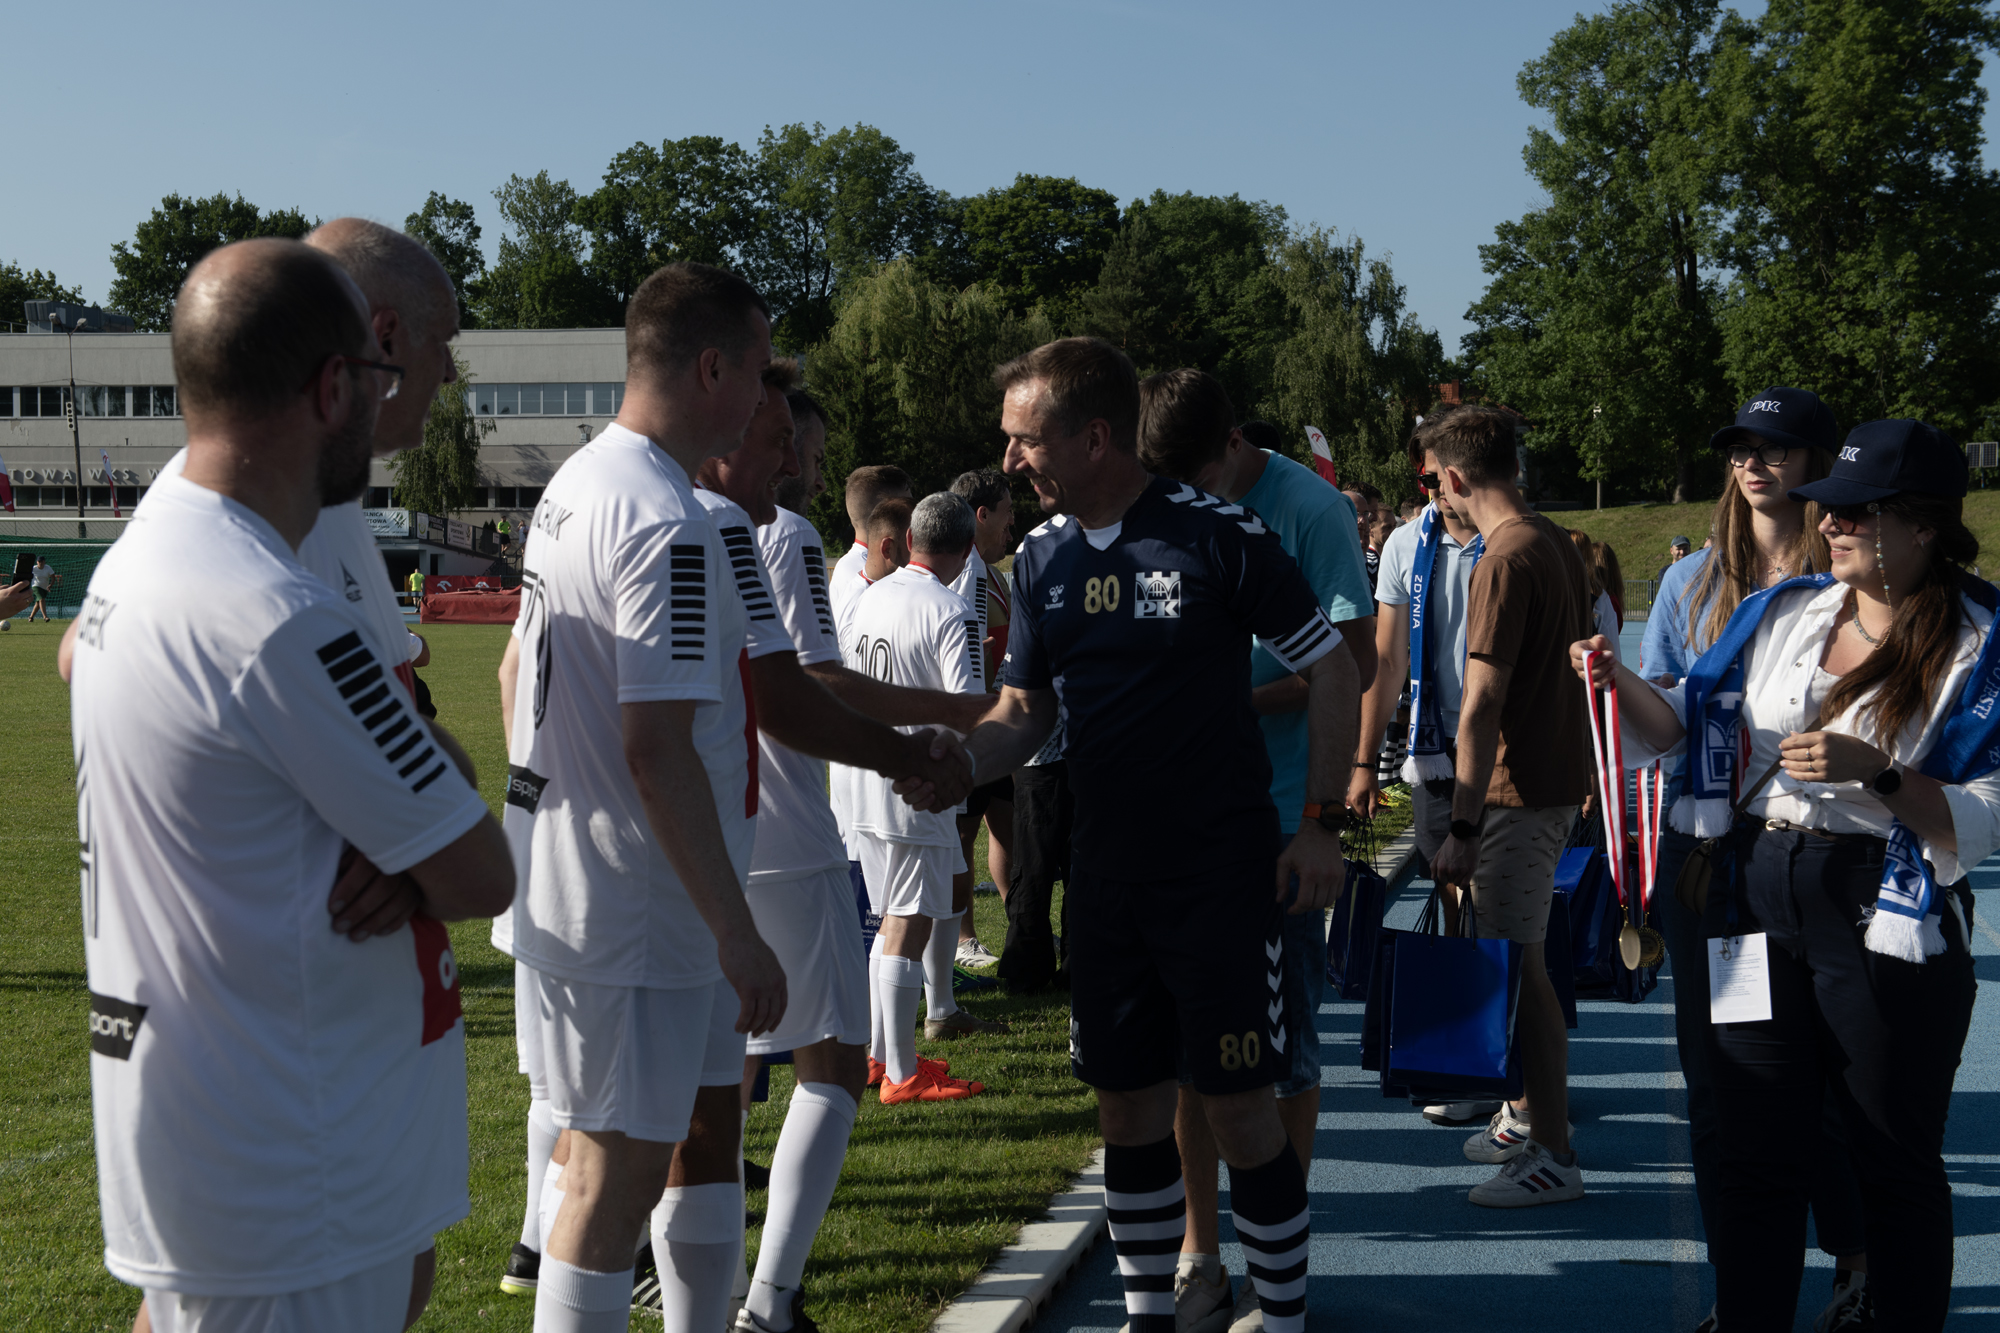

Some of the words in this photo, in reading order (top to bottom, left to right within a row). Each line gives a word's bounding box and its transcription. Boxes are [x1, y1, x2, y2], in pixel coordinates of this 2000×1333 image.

[1748, 400, 1782, 414] PK
[1084, 574, 1121, 614] 80
[1136, 601, 1179, 617] PK
[1412, 574, 1423, 629] ZDYNIA
[855, 634, 893, 685] 10
[1219, 1030, 1260, 1072] 80
